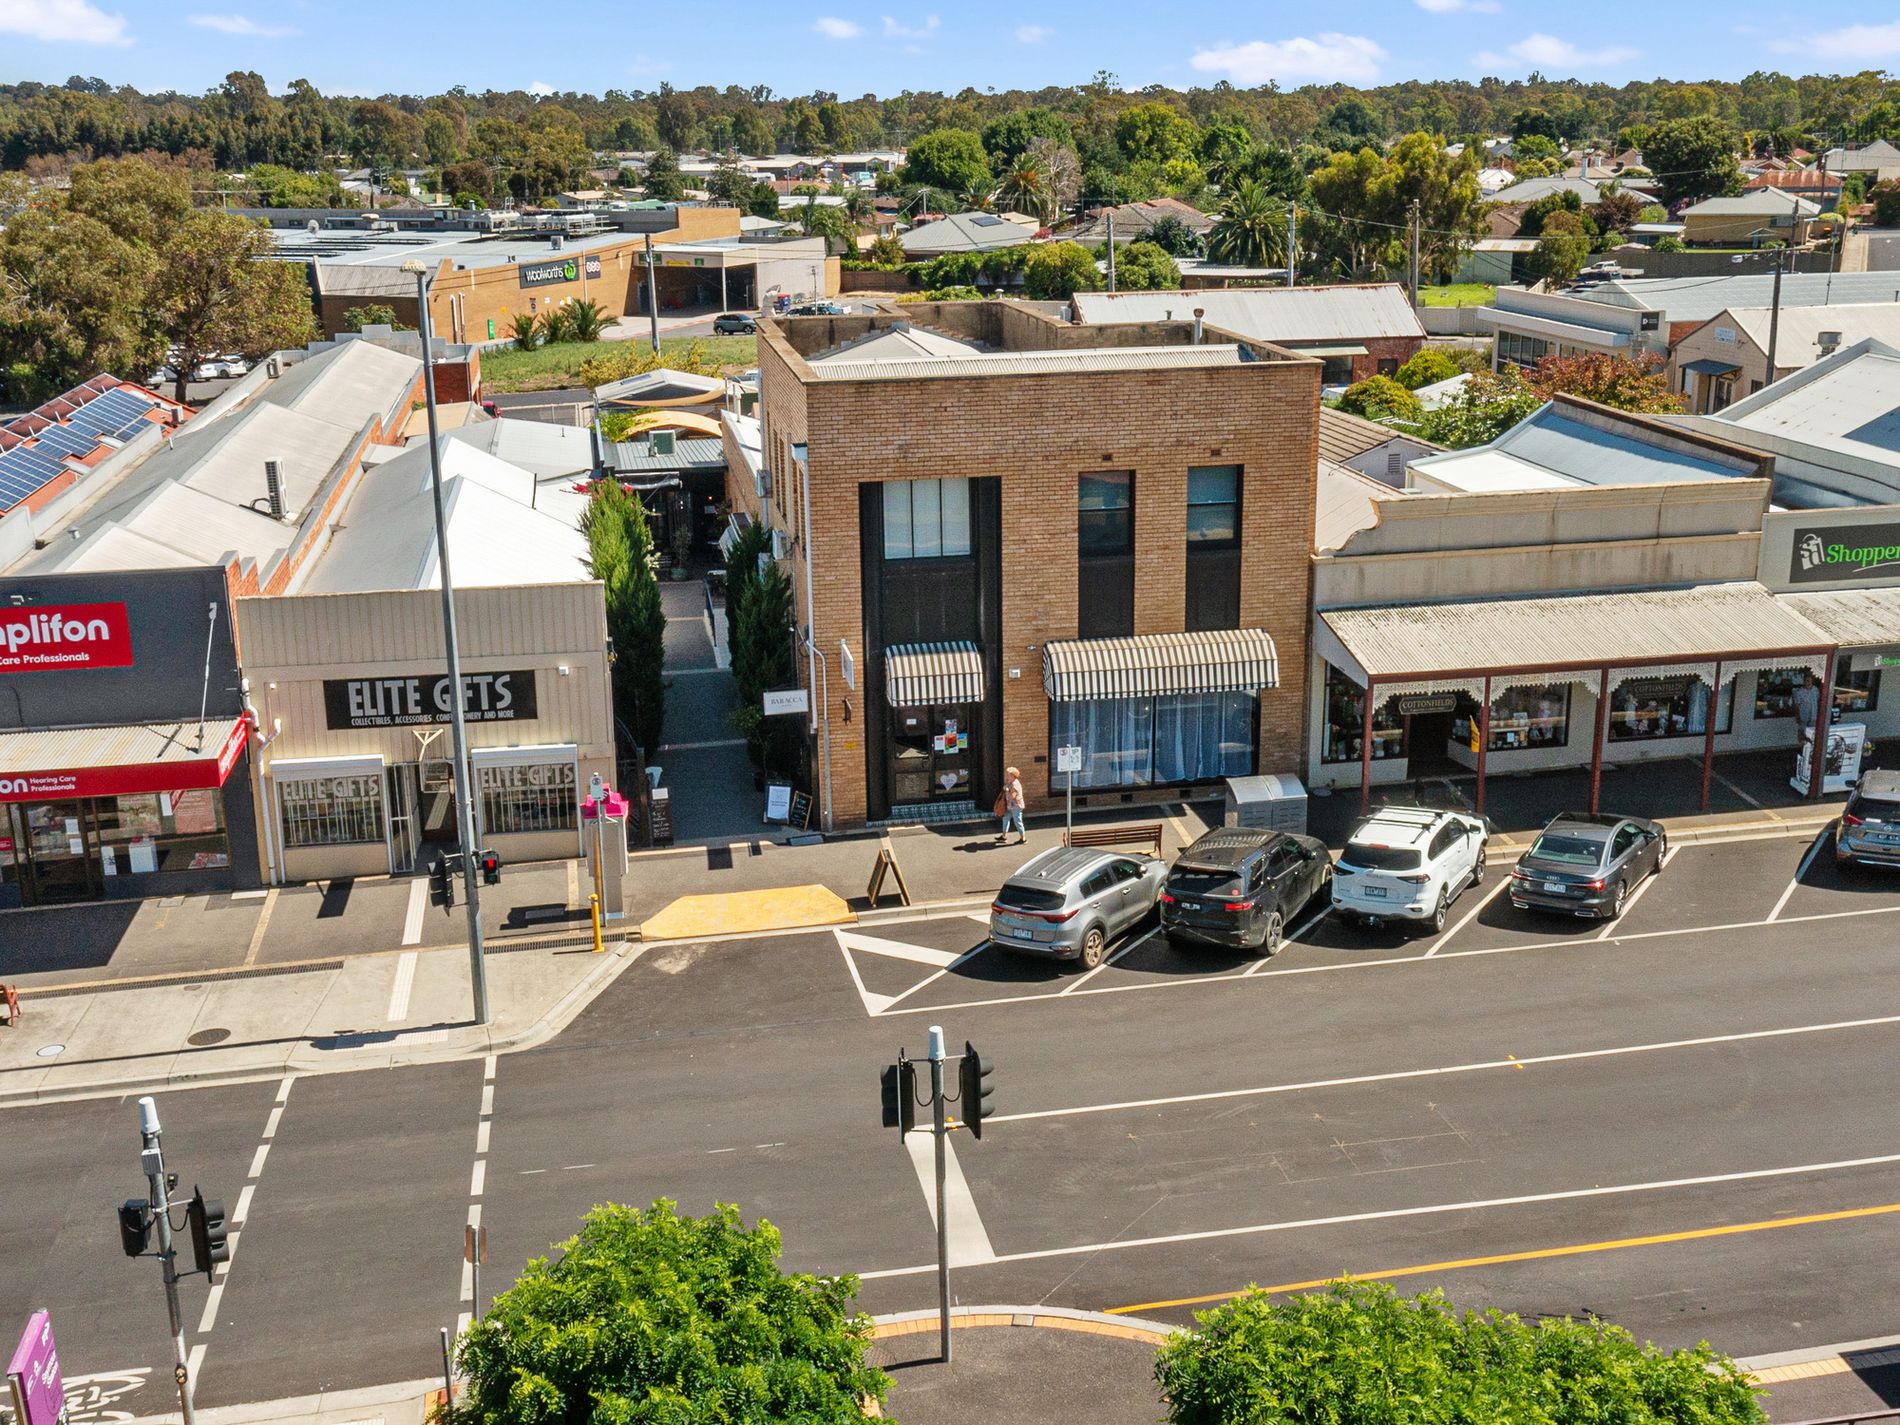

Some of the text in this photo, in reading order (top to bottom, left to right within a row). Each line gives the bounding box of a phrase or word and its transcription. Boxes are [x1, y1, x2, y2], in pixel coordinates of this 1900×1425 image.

[526, 265, 564, 282] Woolworths
[22, 652, 90, 664] Professionals
[347, 674, 512, 717] ELITE GFTS
[1402, 698, 1454, 709] COTTONFIELDS
[483, 711, 496, 719] AND
[497, 709, 514, 718] MORE
[480, 763, 575, 788] ELITE GIFTS
[31, 784, 76, 792] Professionals
[282, 775, 379, 801] ELITE GIFTS
